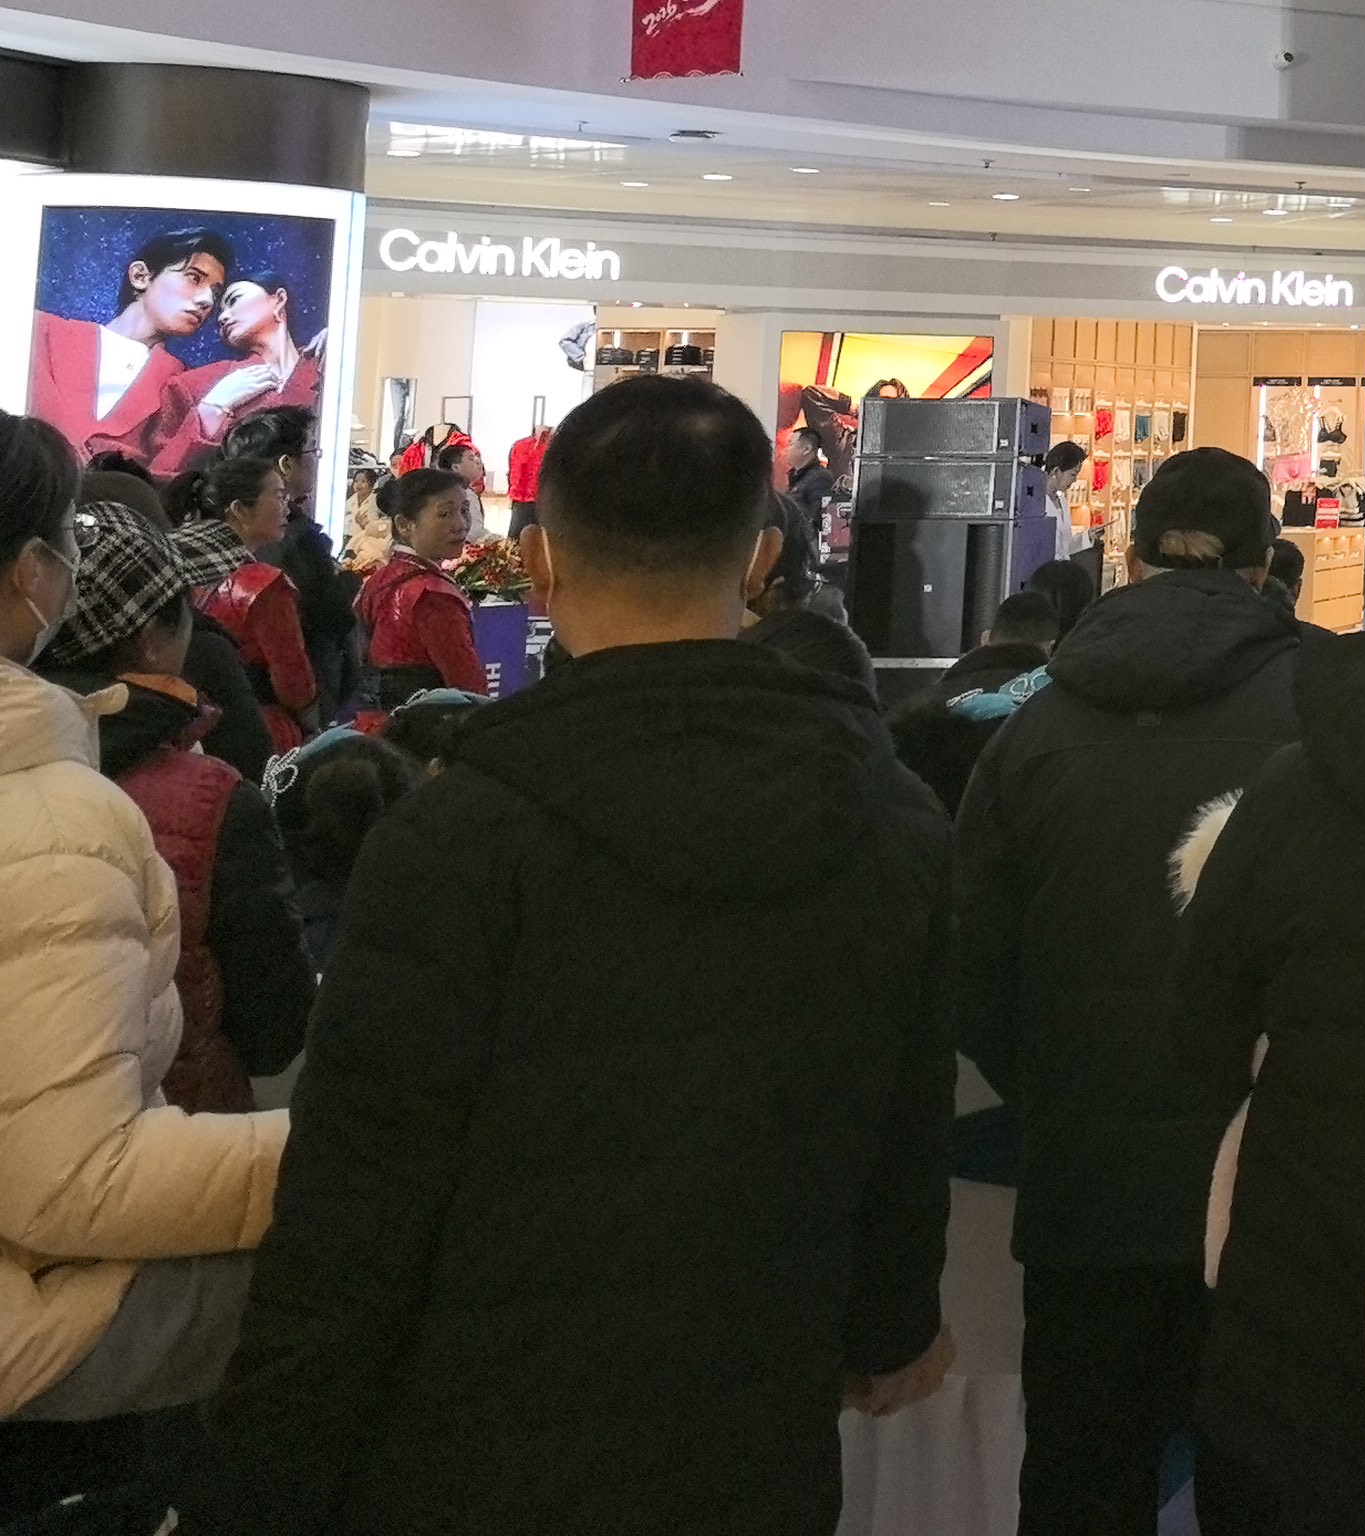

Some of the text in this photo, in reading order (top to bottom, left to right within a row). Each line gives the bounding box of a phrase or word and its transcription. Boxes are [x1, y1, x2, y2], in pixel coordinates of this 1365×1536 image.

[380, 228, 621, 280] Calvin Klein
[1155, 266, 1354, 307] Calvin Klein
